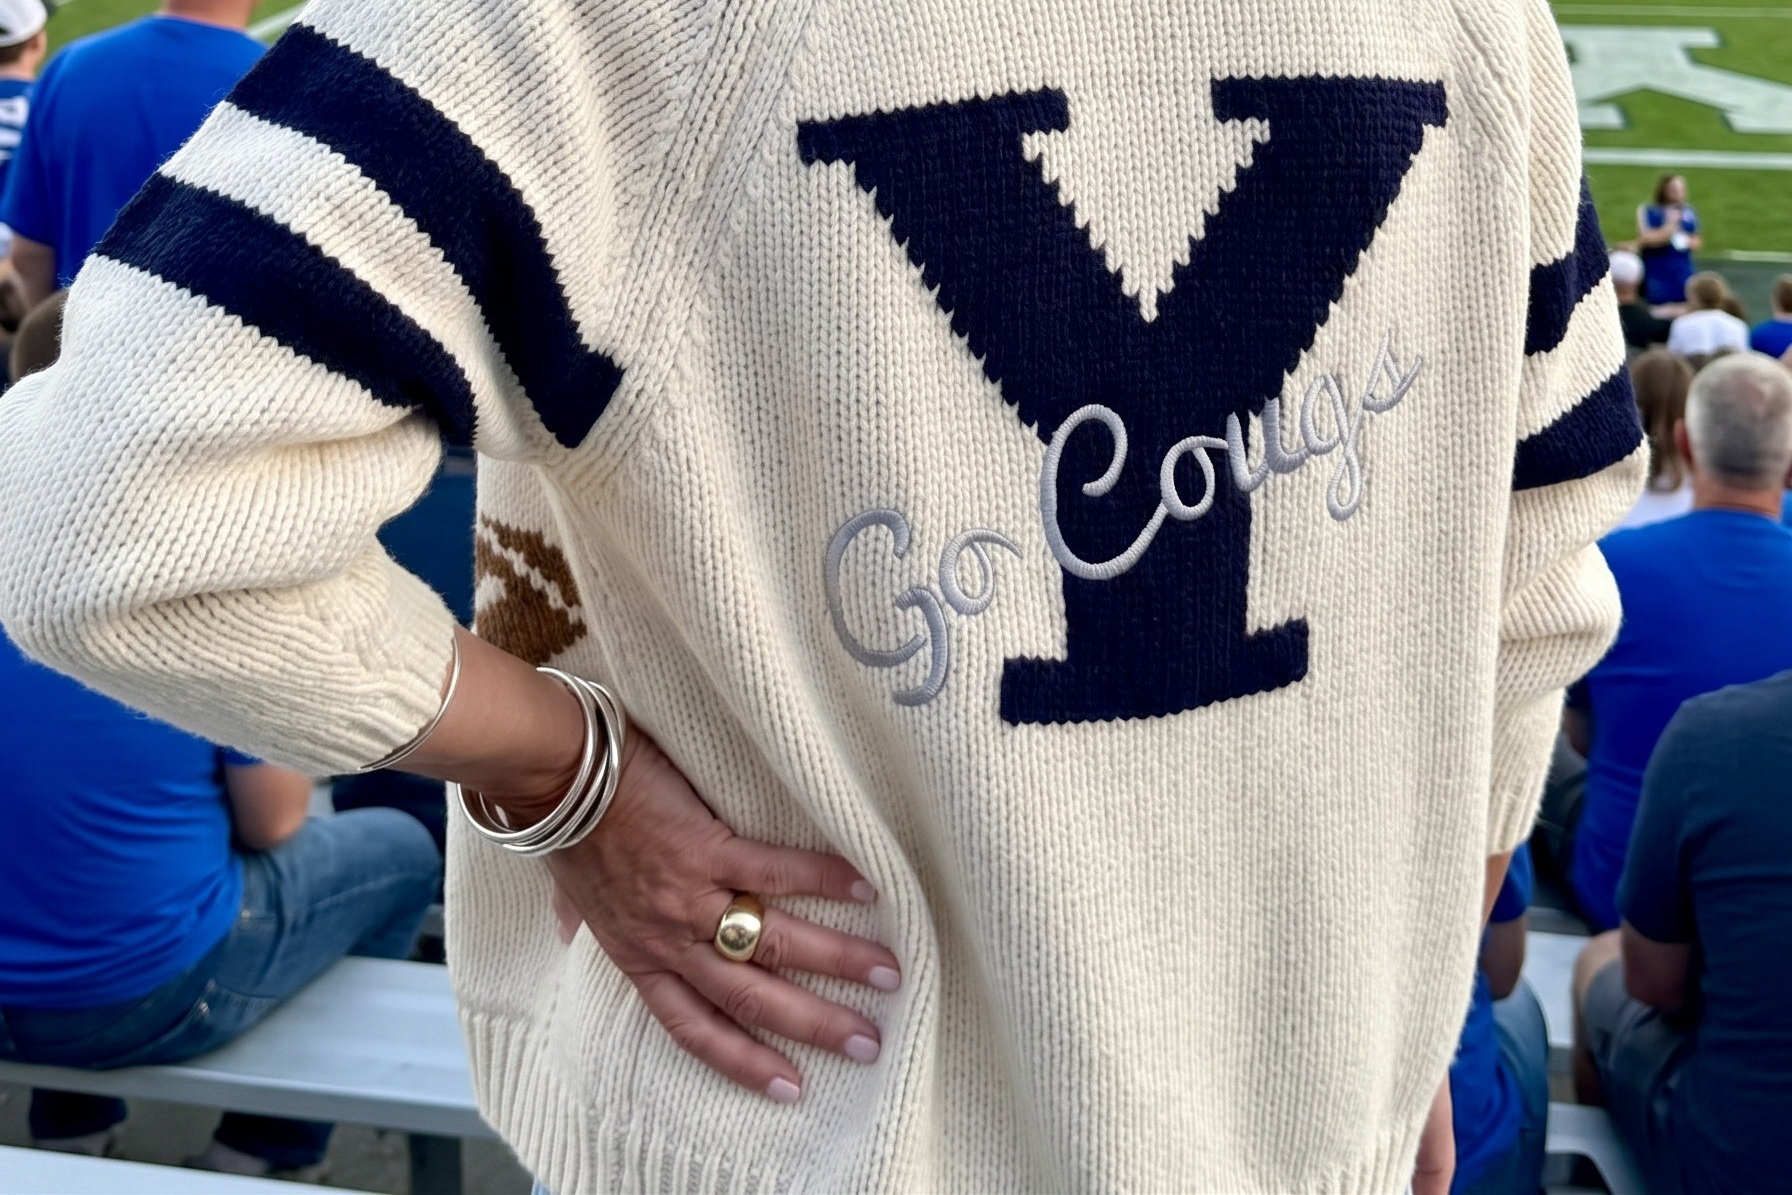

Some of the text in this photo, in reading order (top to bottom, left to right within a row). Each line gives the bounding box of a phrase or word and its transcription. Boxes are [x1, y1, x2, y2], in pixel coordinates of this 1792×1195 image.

[798, 73, 1448, 726] Y
[825, 330, 1422, 705] Go Cougs
